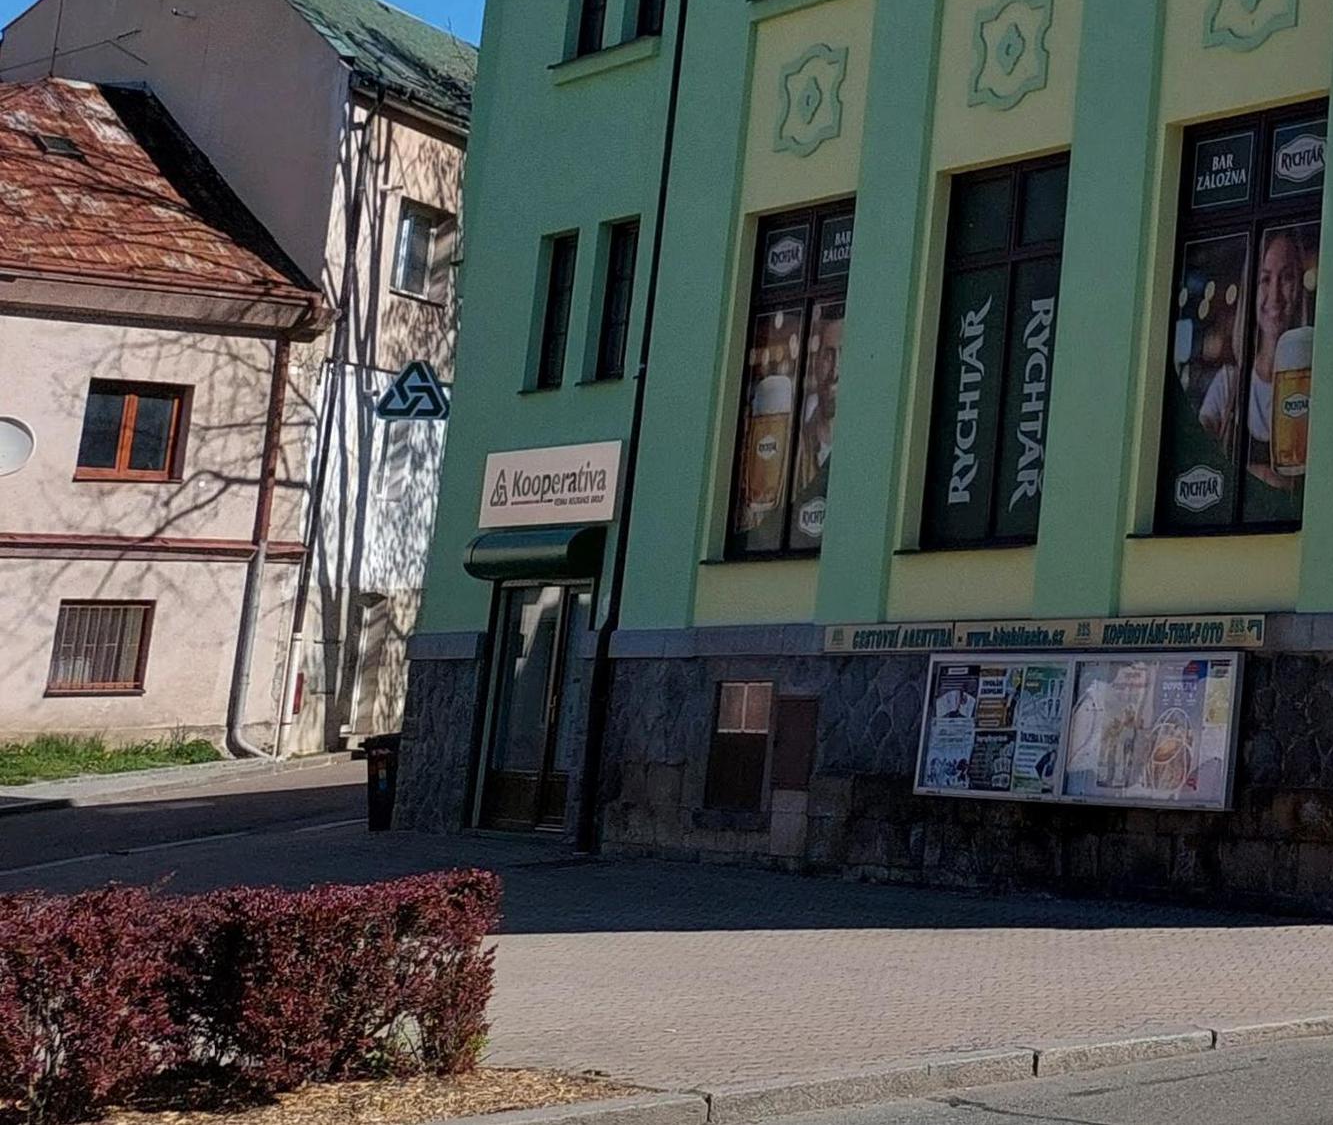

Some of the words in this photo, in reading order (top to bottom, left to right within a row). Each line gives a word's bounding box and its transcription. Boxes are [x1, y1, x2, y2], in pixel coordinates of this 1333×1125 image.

[1196, 168, 1247, 191] ZÁLOŽNA
[1211, 154, 1234, 171] BAR
[948, 294, 992, 504] RYCHTÁŘ
[1008, 296, 1055, 512] RYCHTÁŘ
[512, 460, 606, 503] Kooperativa
